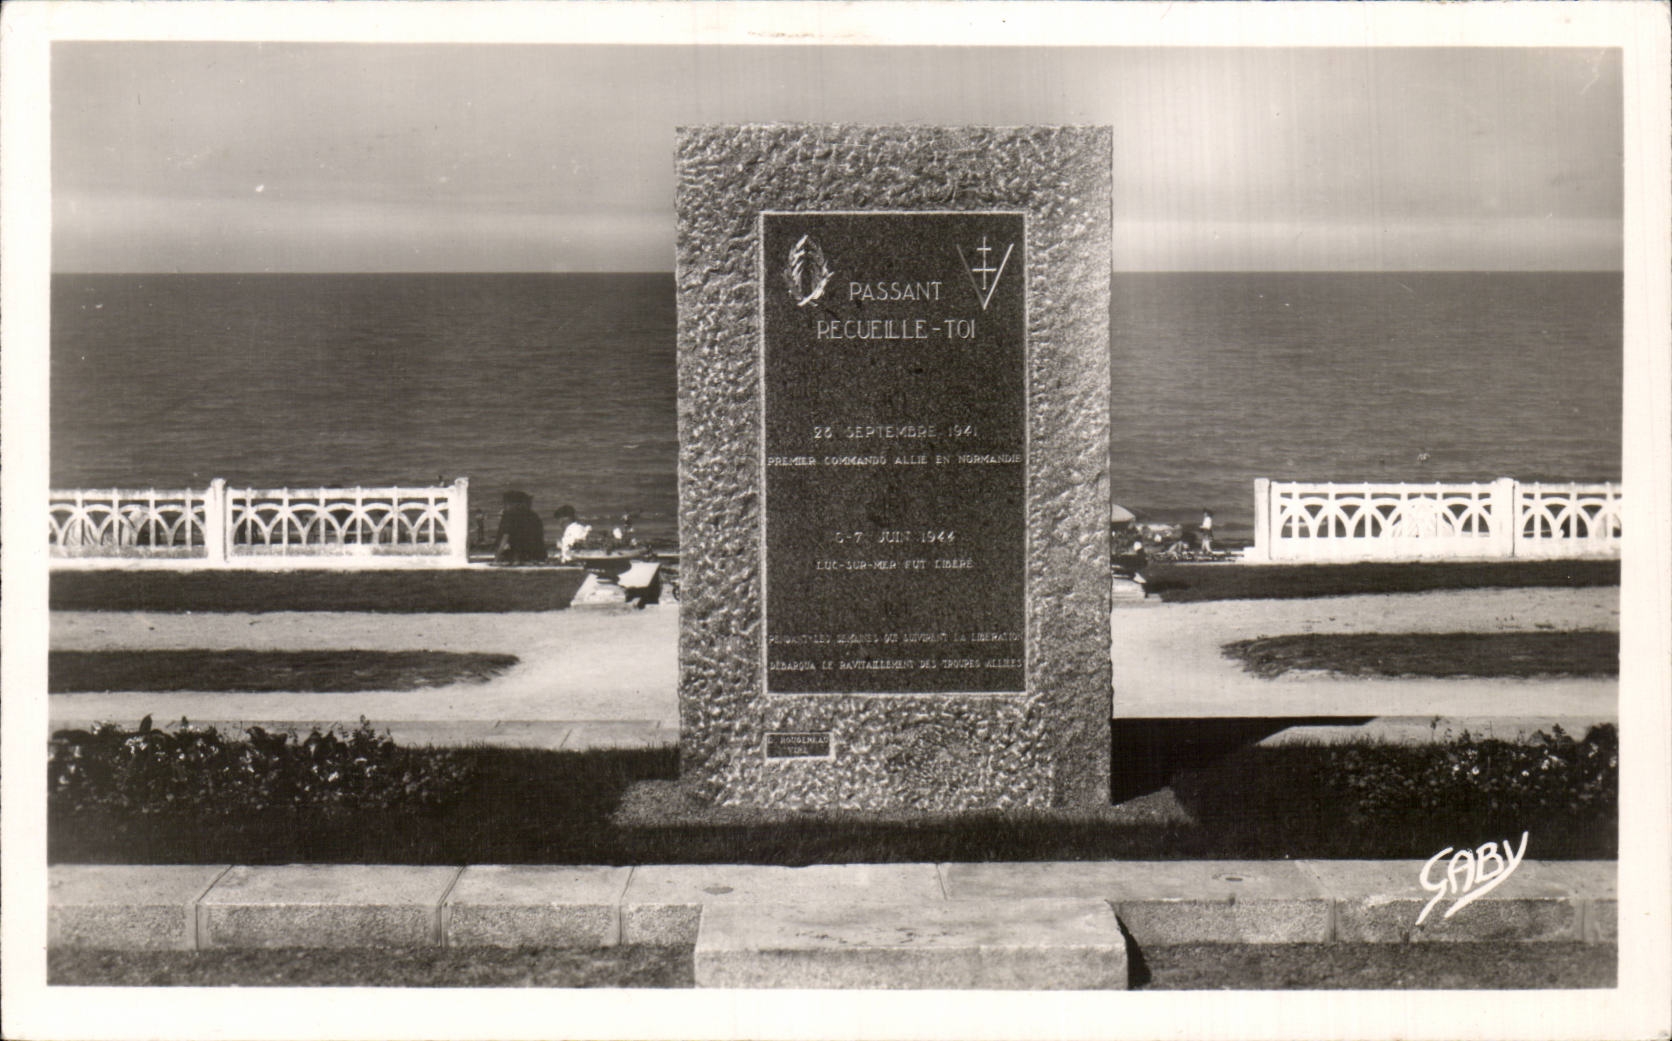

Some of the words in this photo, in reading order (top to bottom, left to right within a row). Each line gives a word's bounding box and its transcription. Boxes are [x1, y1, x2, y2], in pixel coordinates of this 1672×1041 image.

[849, 281, 943, 301] PASSANT
[846, 425, 937, 438] SEPTEMBRE
[948, 424, 978, 437] 1941
[767, 456, 817, 466] PREMIER
[824, 455, 887, 466] COMMANDO
[935, 455, 950, 464] EN
[958, 454, 1022, 464] NORMANDIE
[878, 531, 911, 543] JUIN
[920, 530, 956, 543] 1944
[816, 560, 897, 571] LUC-SUR-MER
[904, 559, 928, 569] FUT
[953, 632, 967, 642] LA
[822, 660, 834, 670] LE
[839, 659, 915, 670] RAVITAILLEMENT
[919, 659, 937, 669] DES
[942, 659, 981, 669] TROUPES
